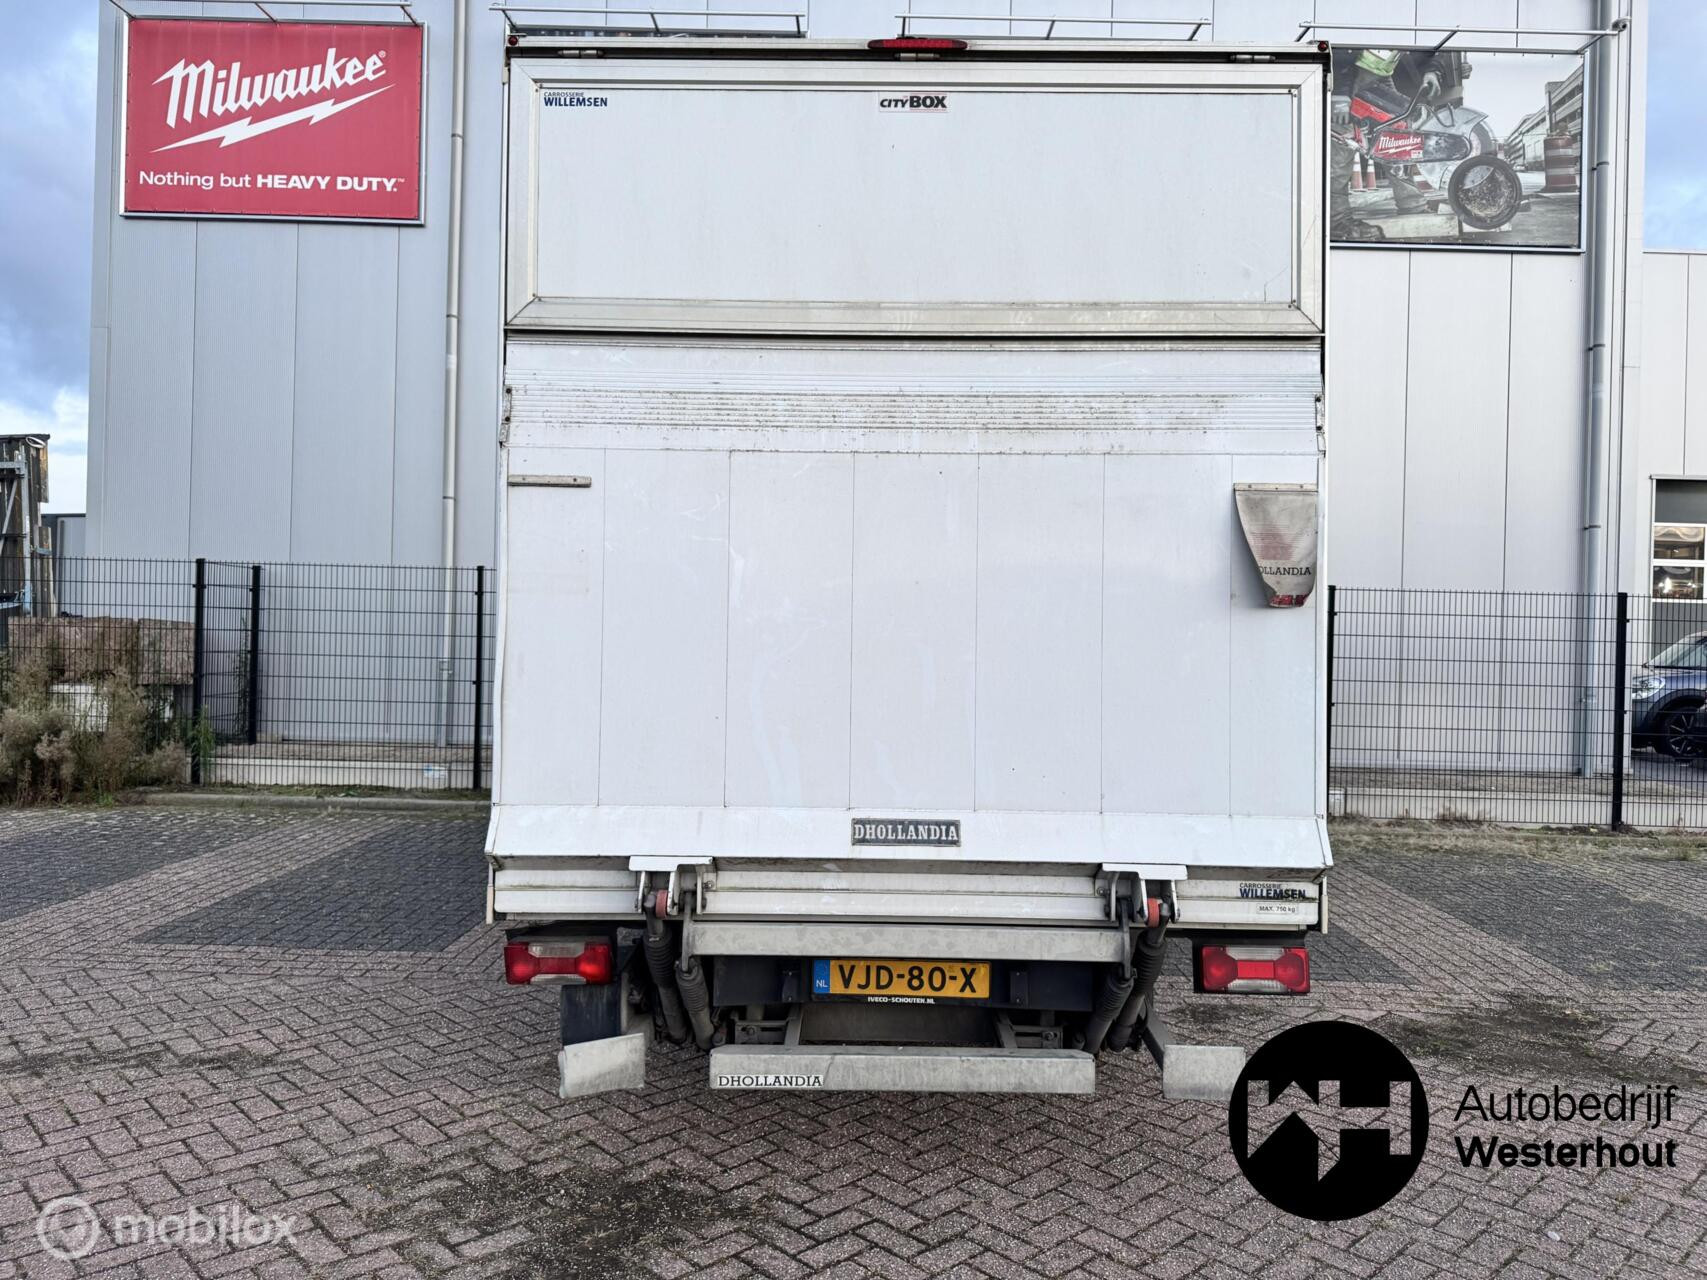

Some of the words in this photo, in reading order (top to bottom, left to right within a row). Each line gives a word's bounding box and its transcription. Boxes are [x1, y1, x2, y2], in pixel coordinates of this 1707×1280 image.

[543, 97, 608, 107] WILLEMSEN
[1378, 136, 1421, 149] Milwaukee
[139, 171, 214, 190] Nothing
[220, 173, 251, 188] but
[256, 174, 331, 191] HEAVY
[854, 824, 959, 840] DHOLLANDIA
[1240, 888, 1306, 899] WILLEMSEN
[816, 979, 828, 988] NL
[838, 964, 977, 993] VJD-80-X
[868, 996, 935, 1004] IVECO-SCHOUTEN.NL
[719, 1075, 821, 1087] DHOLLANDIA
